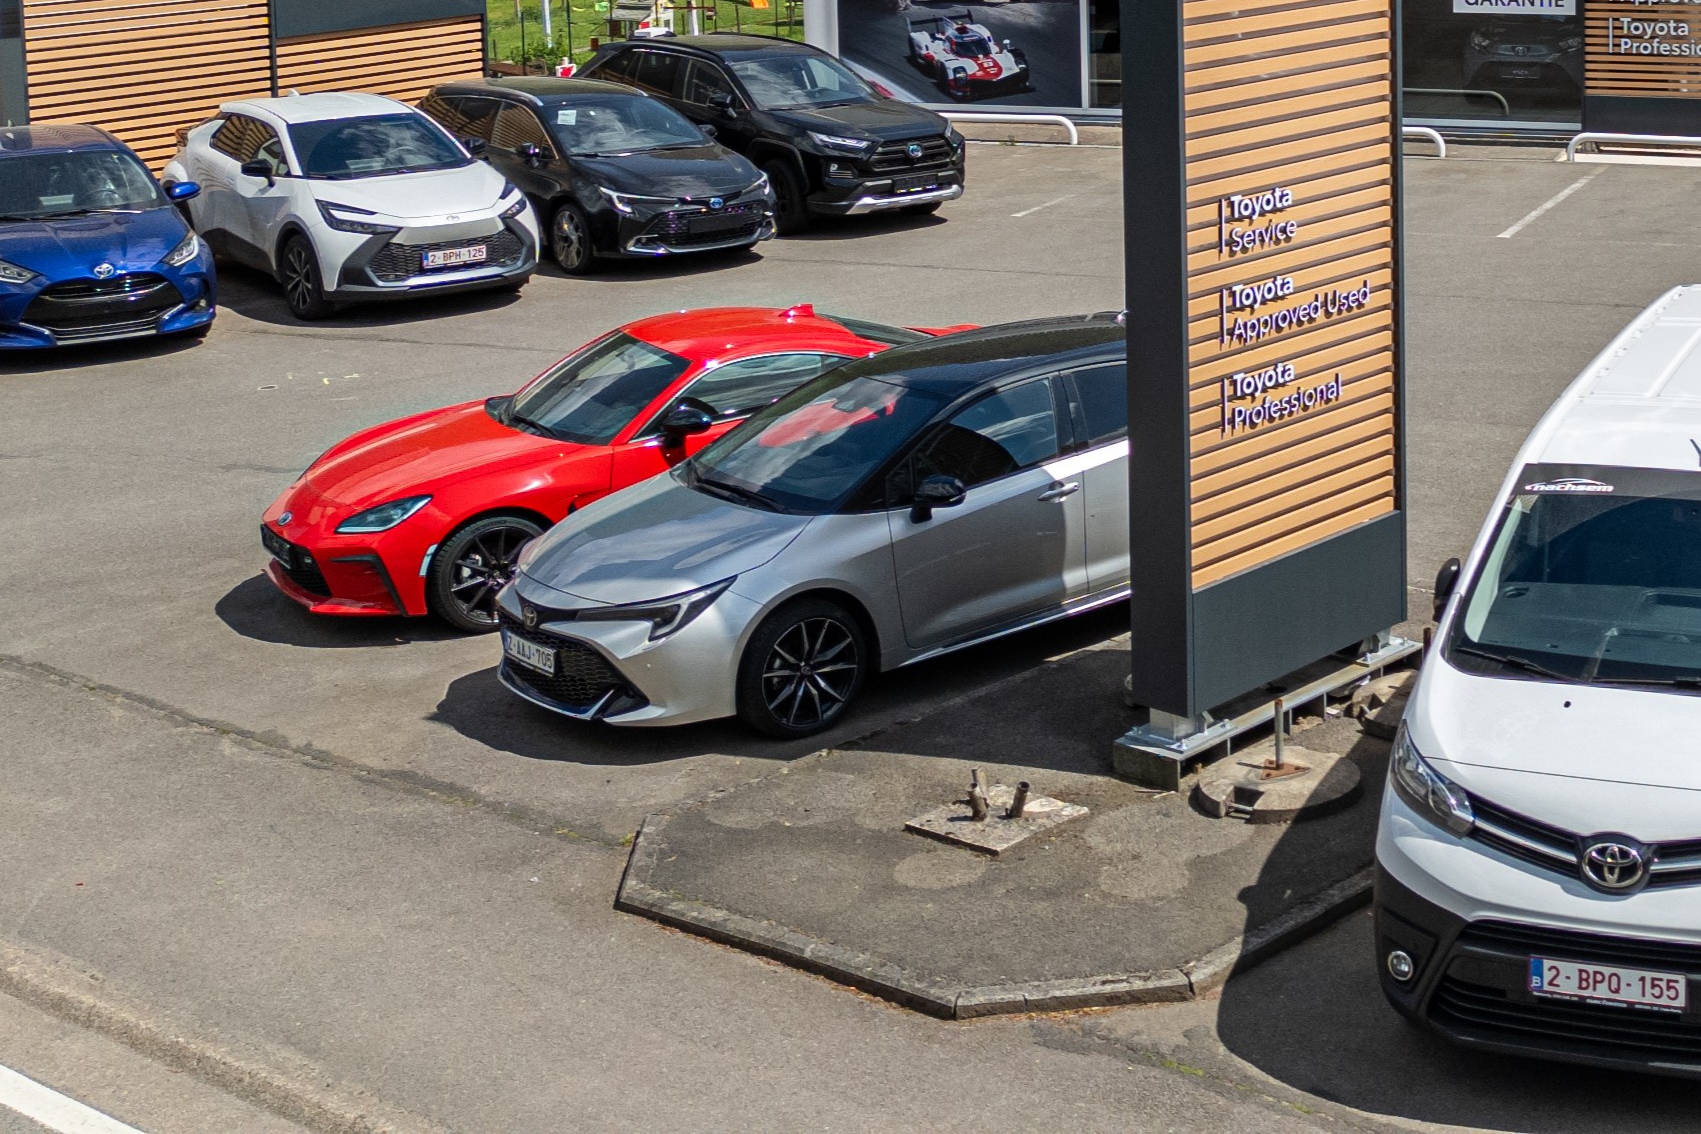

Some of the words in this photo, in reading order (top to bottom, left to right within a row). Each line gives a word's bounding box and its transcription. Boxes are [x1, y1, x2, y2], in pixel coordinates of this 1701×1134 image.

[1620, 17, 1689, 39] Toyota
[1230, 186, 1294, 220] Toyota
[1231, 219, 1297, 252] Service
[1232, 275, 1294, 309] Toyota
[1233, 293, 1320, 345] Approved
[1326, 280, 1370, 313] Used
[1233, 362, 1296, 398] Toyota
[1235, 373, 1343, 430] Professional
[1532, 483, 1614, 492] nachsem
[1532, 976, 1541, 987] B
